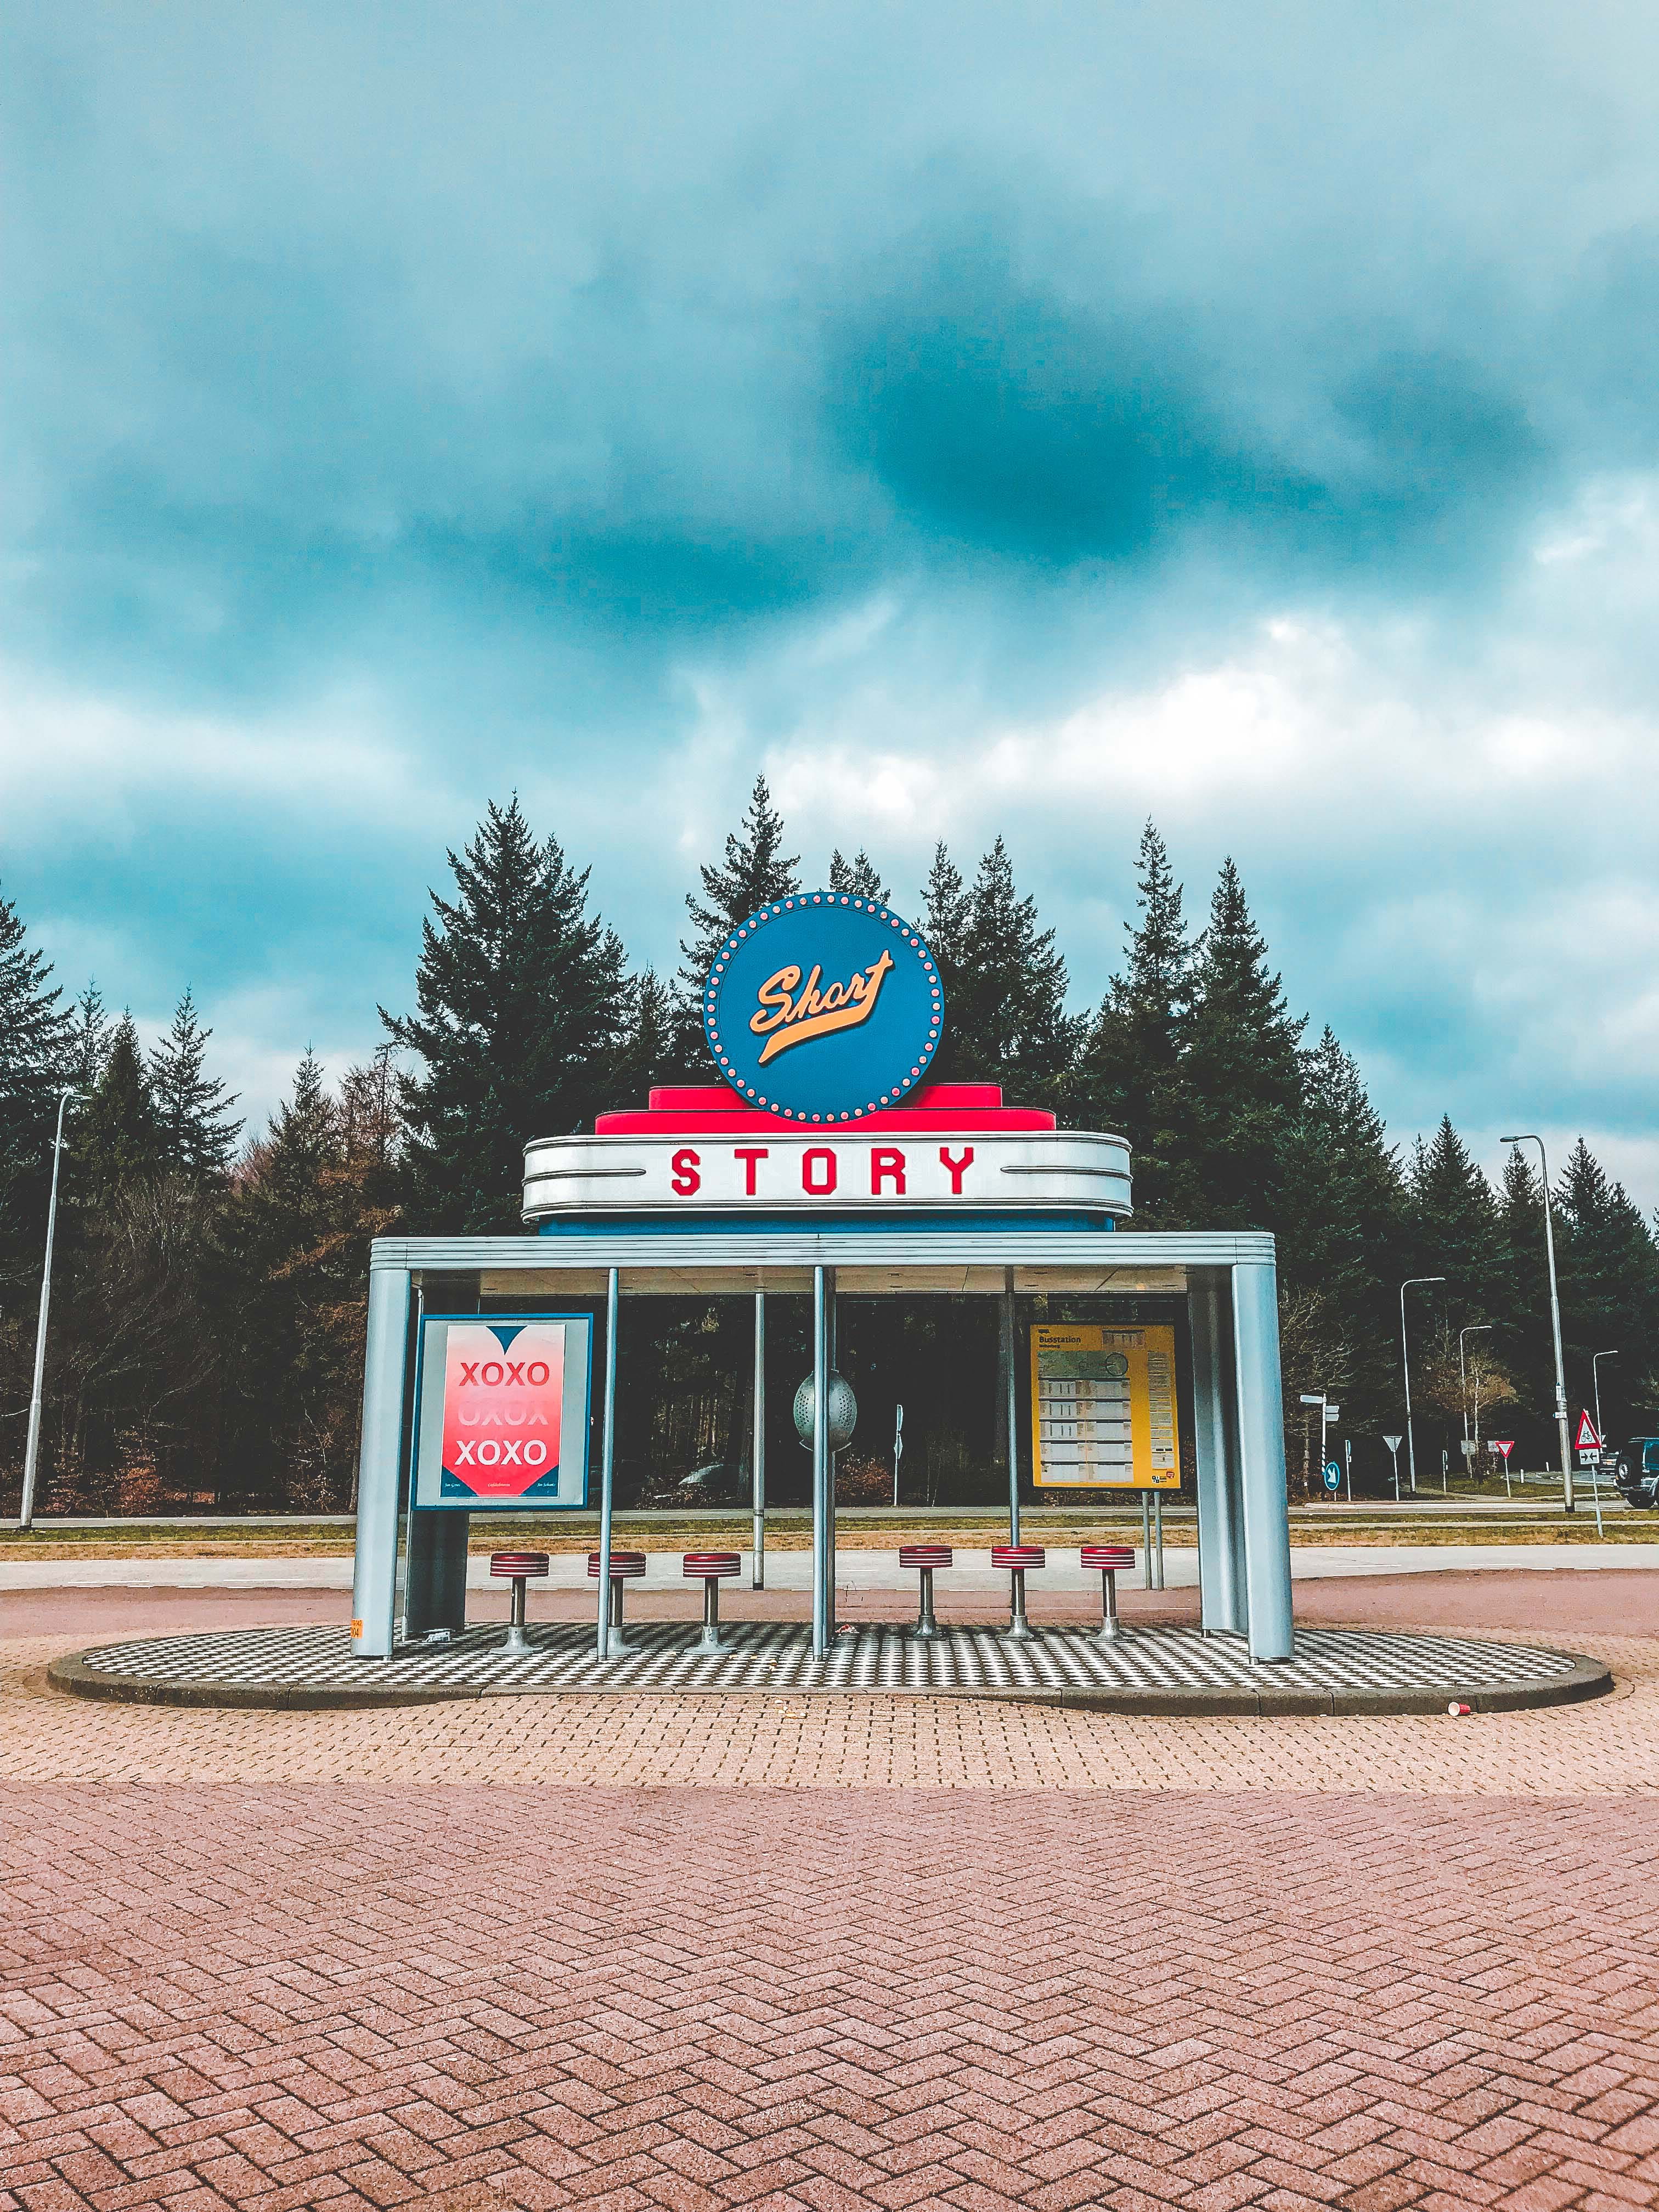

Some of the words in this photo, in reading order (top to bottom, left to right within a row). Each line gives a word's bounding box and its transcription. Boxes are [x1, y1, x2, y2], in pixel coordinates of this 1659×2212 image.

[749, 950, 894, 1063] Short
[672, 1147, 974, 1196] STORY
[1039, 1335, 1081, 1344] Busstation
[459, 1362, 550, 1386] XOXO
[454, 1439, 548, 1466] XOXO
